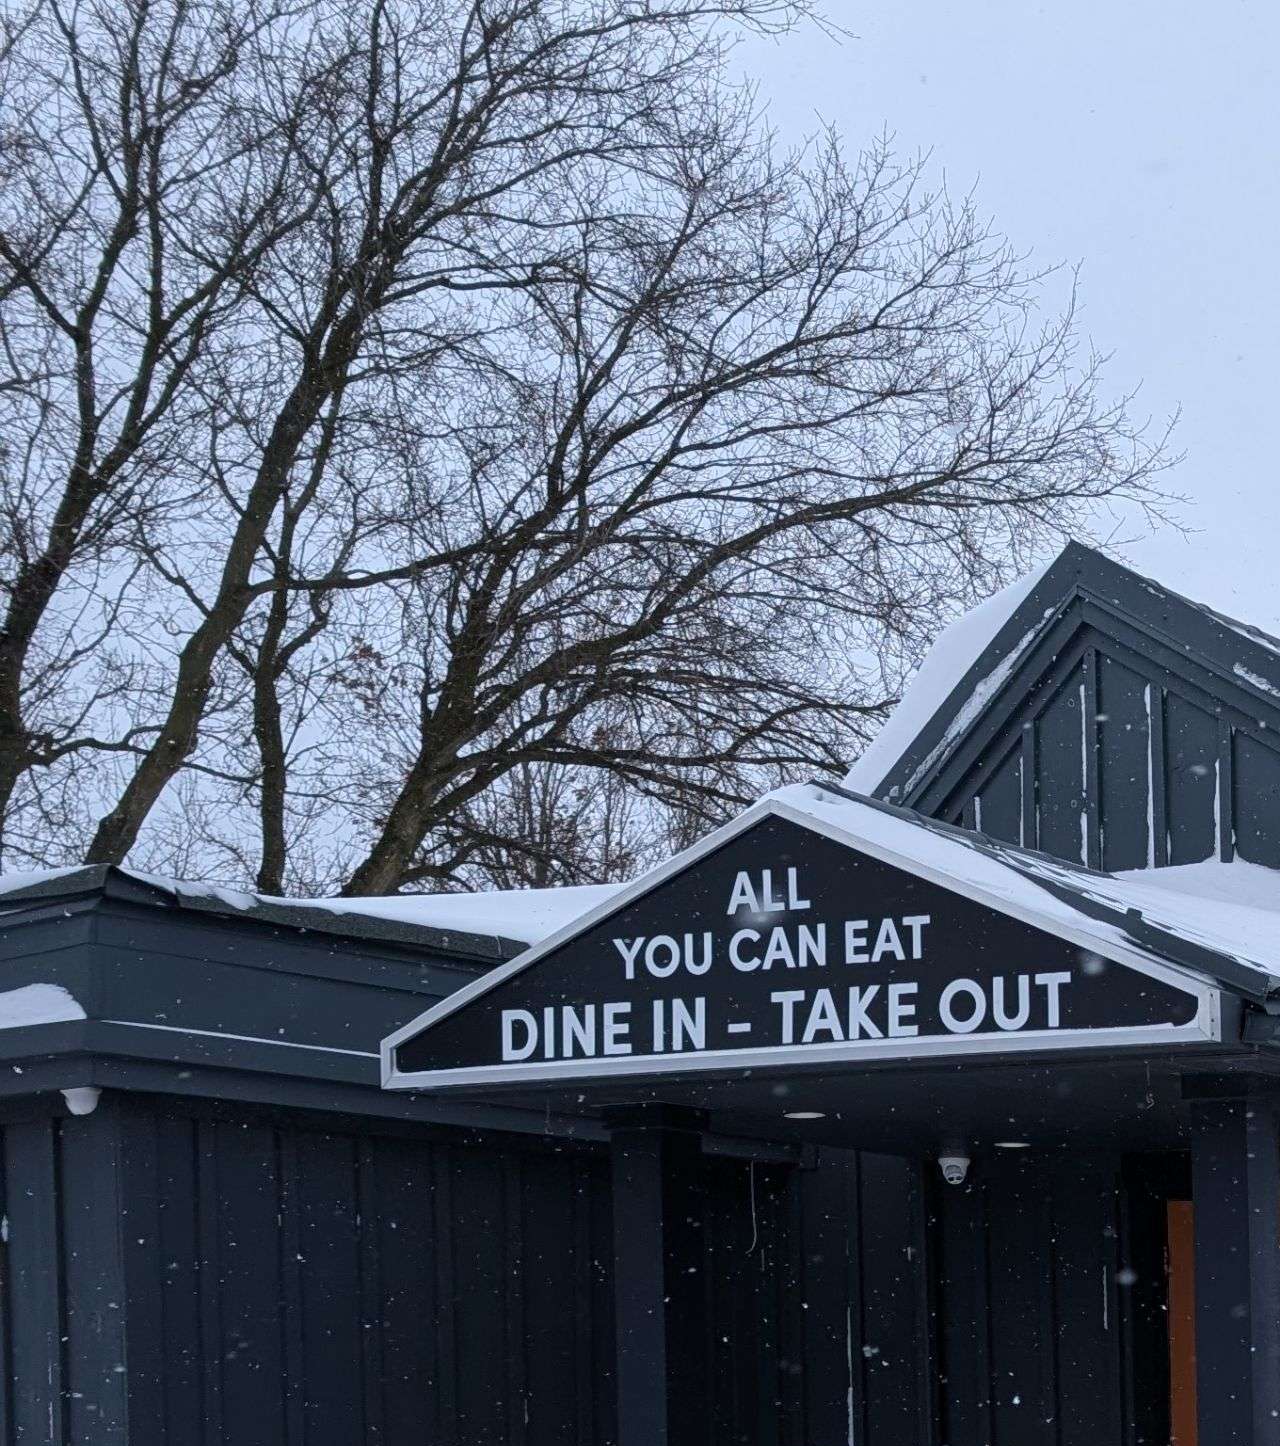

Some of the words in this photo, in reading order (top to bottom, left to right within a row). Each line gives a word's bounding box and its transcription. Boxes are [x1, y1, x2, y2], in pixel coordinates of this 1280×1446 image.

[726, 867, 811, 915] ALL
[612, 931, 712, 980] YOU
[729, 923, 827, 972] CAN
[844, 914, 931, 964] EAT
[501, 1001, 632, 1061] DINE
[653, 997, 706, 1052] IN
[770, 982, 919, 1044] TAKE
[938, 971, 1071, 1034] OUT
